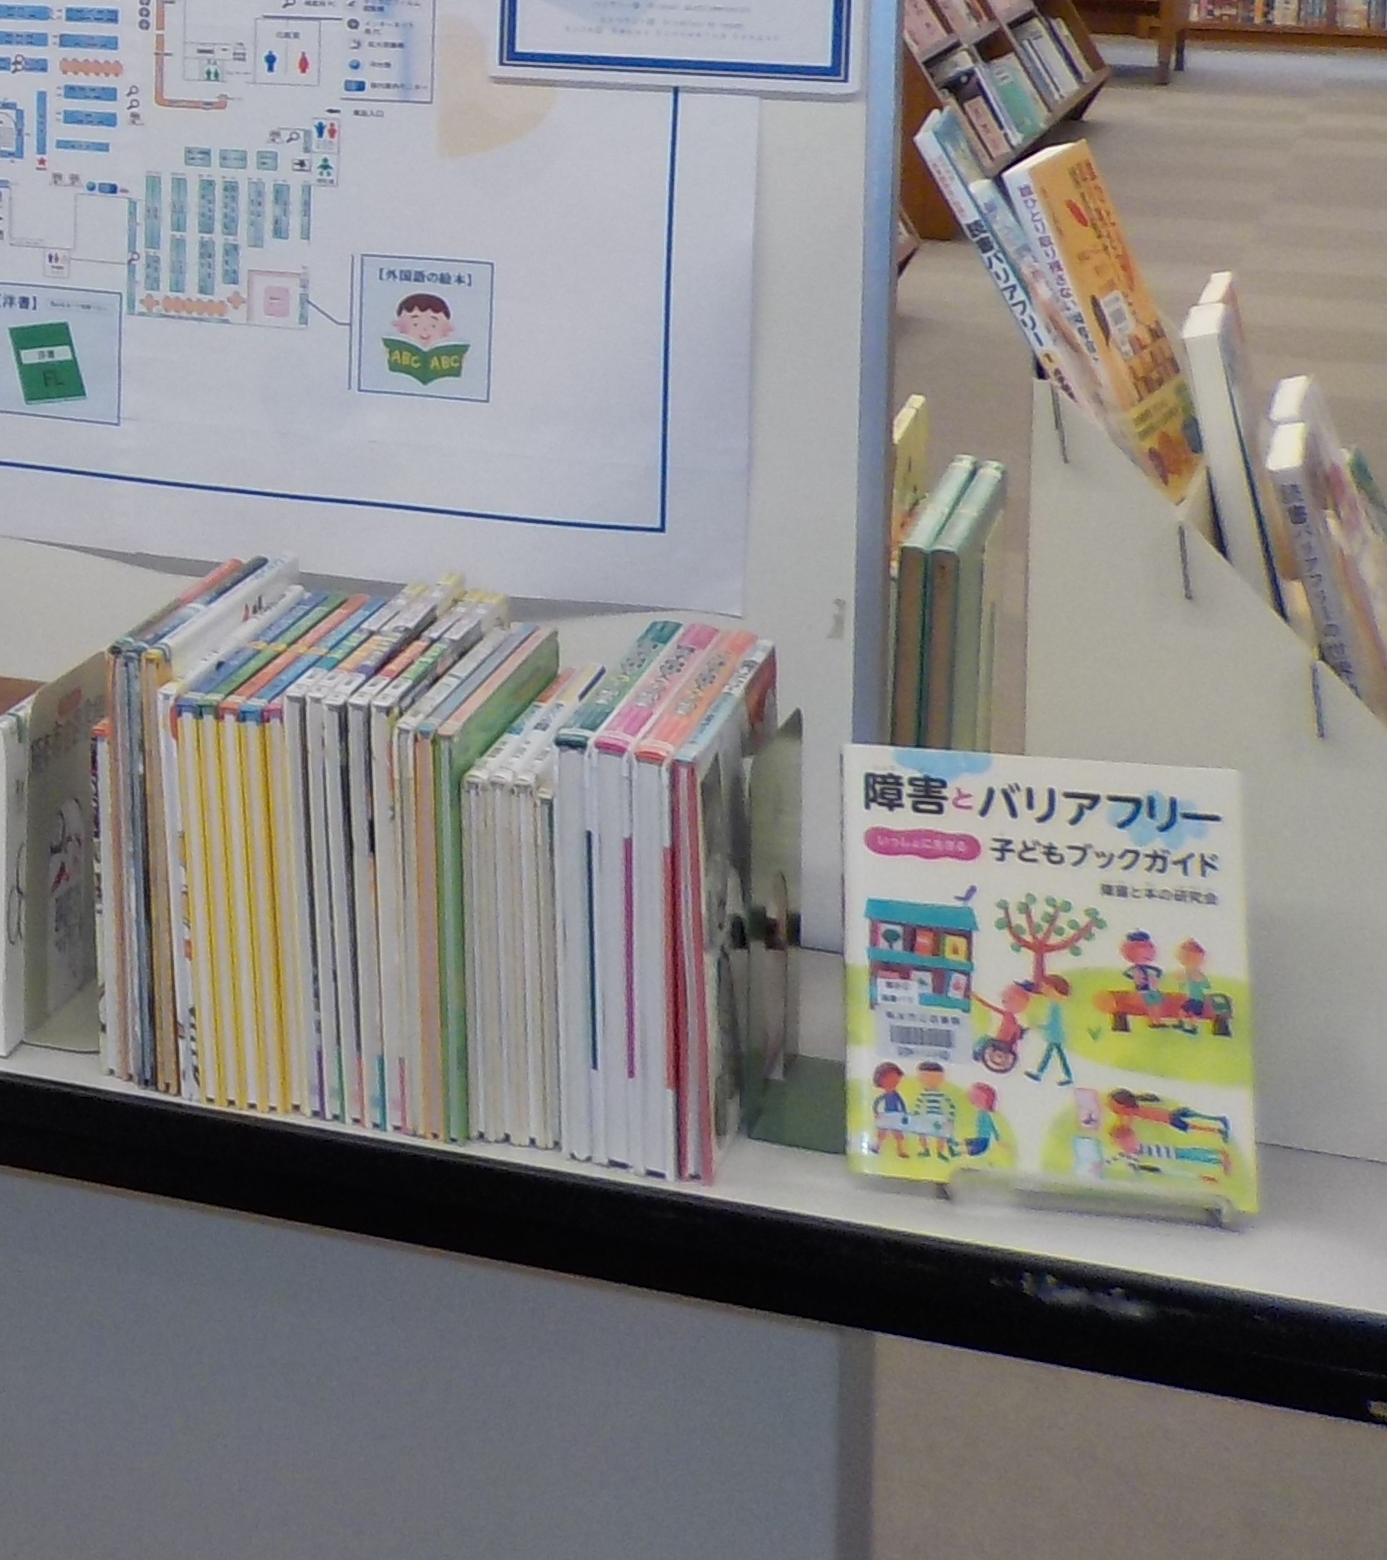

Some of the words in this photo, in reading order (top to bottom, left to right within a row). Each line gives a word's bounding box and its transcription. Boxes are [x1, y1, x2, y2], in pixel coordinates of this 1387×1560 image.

[378, 266, 473, 287] 【外国語の絵本】
[965, 218, 1046, 348] 読書バリアフリー
[391, 348, 423, 370] ABC
[430, 353, 461, 370] ABC
[863, 771, 1223, 833] 障害とバリアフリー
[989, 836, 1220, 879] 子どもブックガイド
[1099, 882, 1220, 907] 障害と本の研究会
